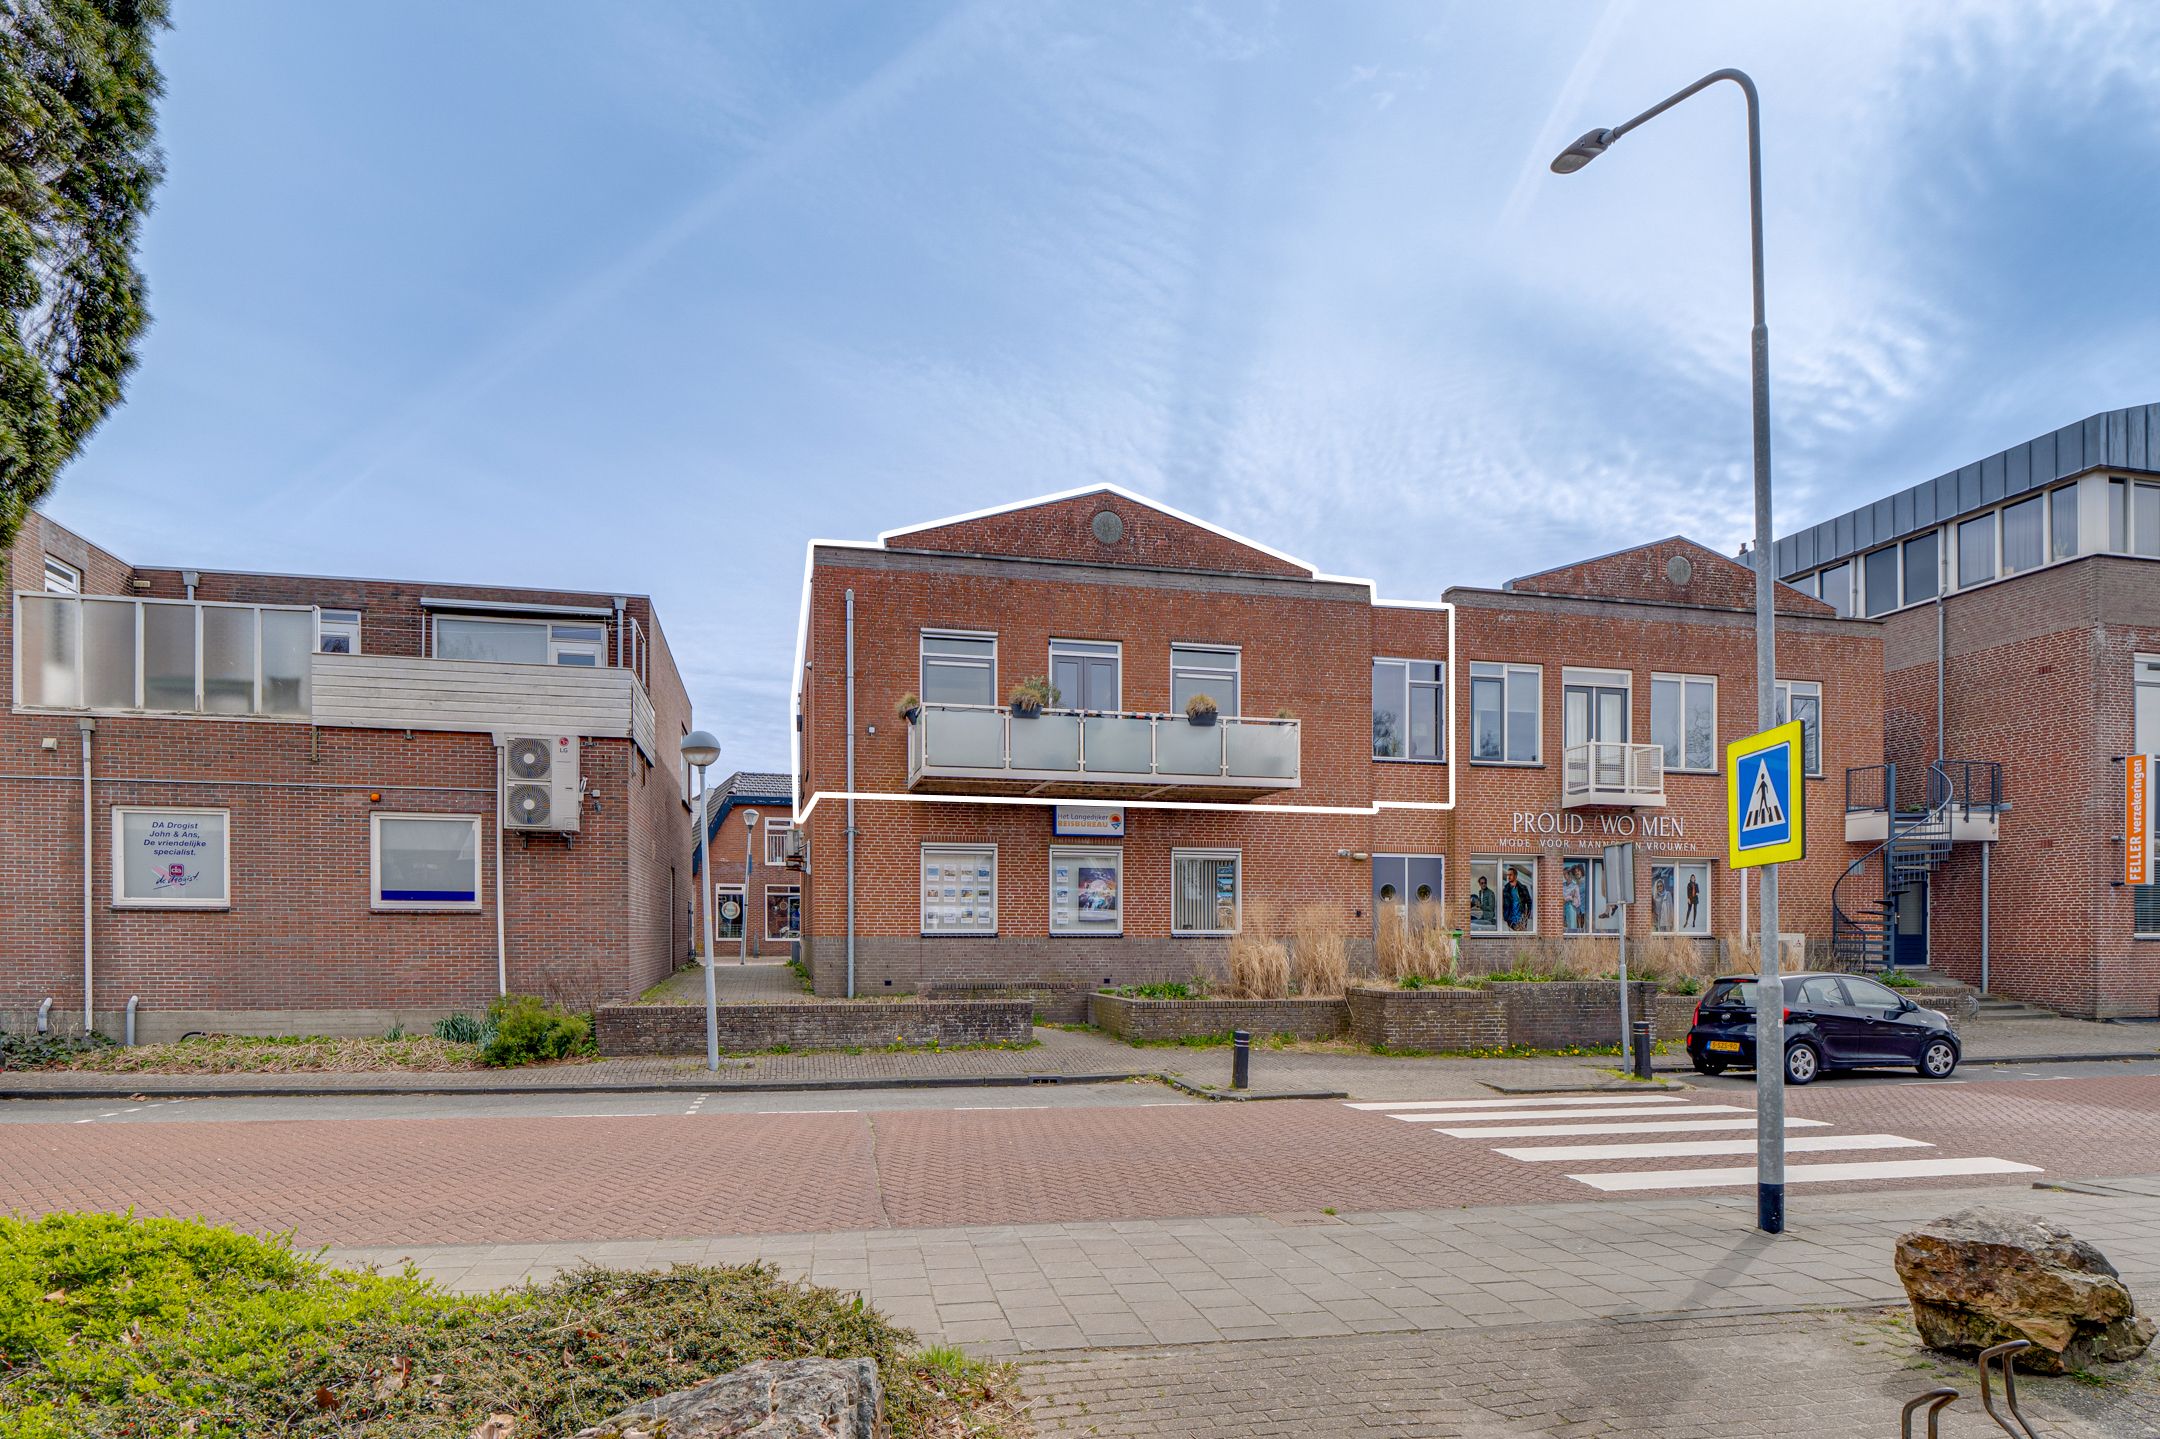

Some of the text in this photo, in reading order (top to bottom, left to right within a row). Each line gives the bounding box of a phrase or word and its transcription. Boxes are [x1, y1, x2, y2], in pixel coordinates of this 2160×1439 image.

[1057, 820, 1108, 828] REISBUREAU
[1512, 812, 1584, 834] PROUD
[2129, 759, 2145, 881] FELLER verzekeringen
[152, 821, 198, 830] DA Drogist
[149, 830, 171, 838] John
[181, 831, 200, 839] Ans,
[158, 840, 207, 848] vriendelijke
[1499, 838, 1531, 848] MODE
[1540, 839, 1570, 849] VOOR
[1646, 841, 1697, 852] VROUWEN
